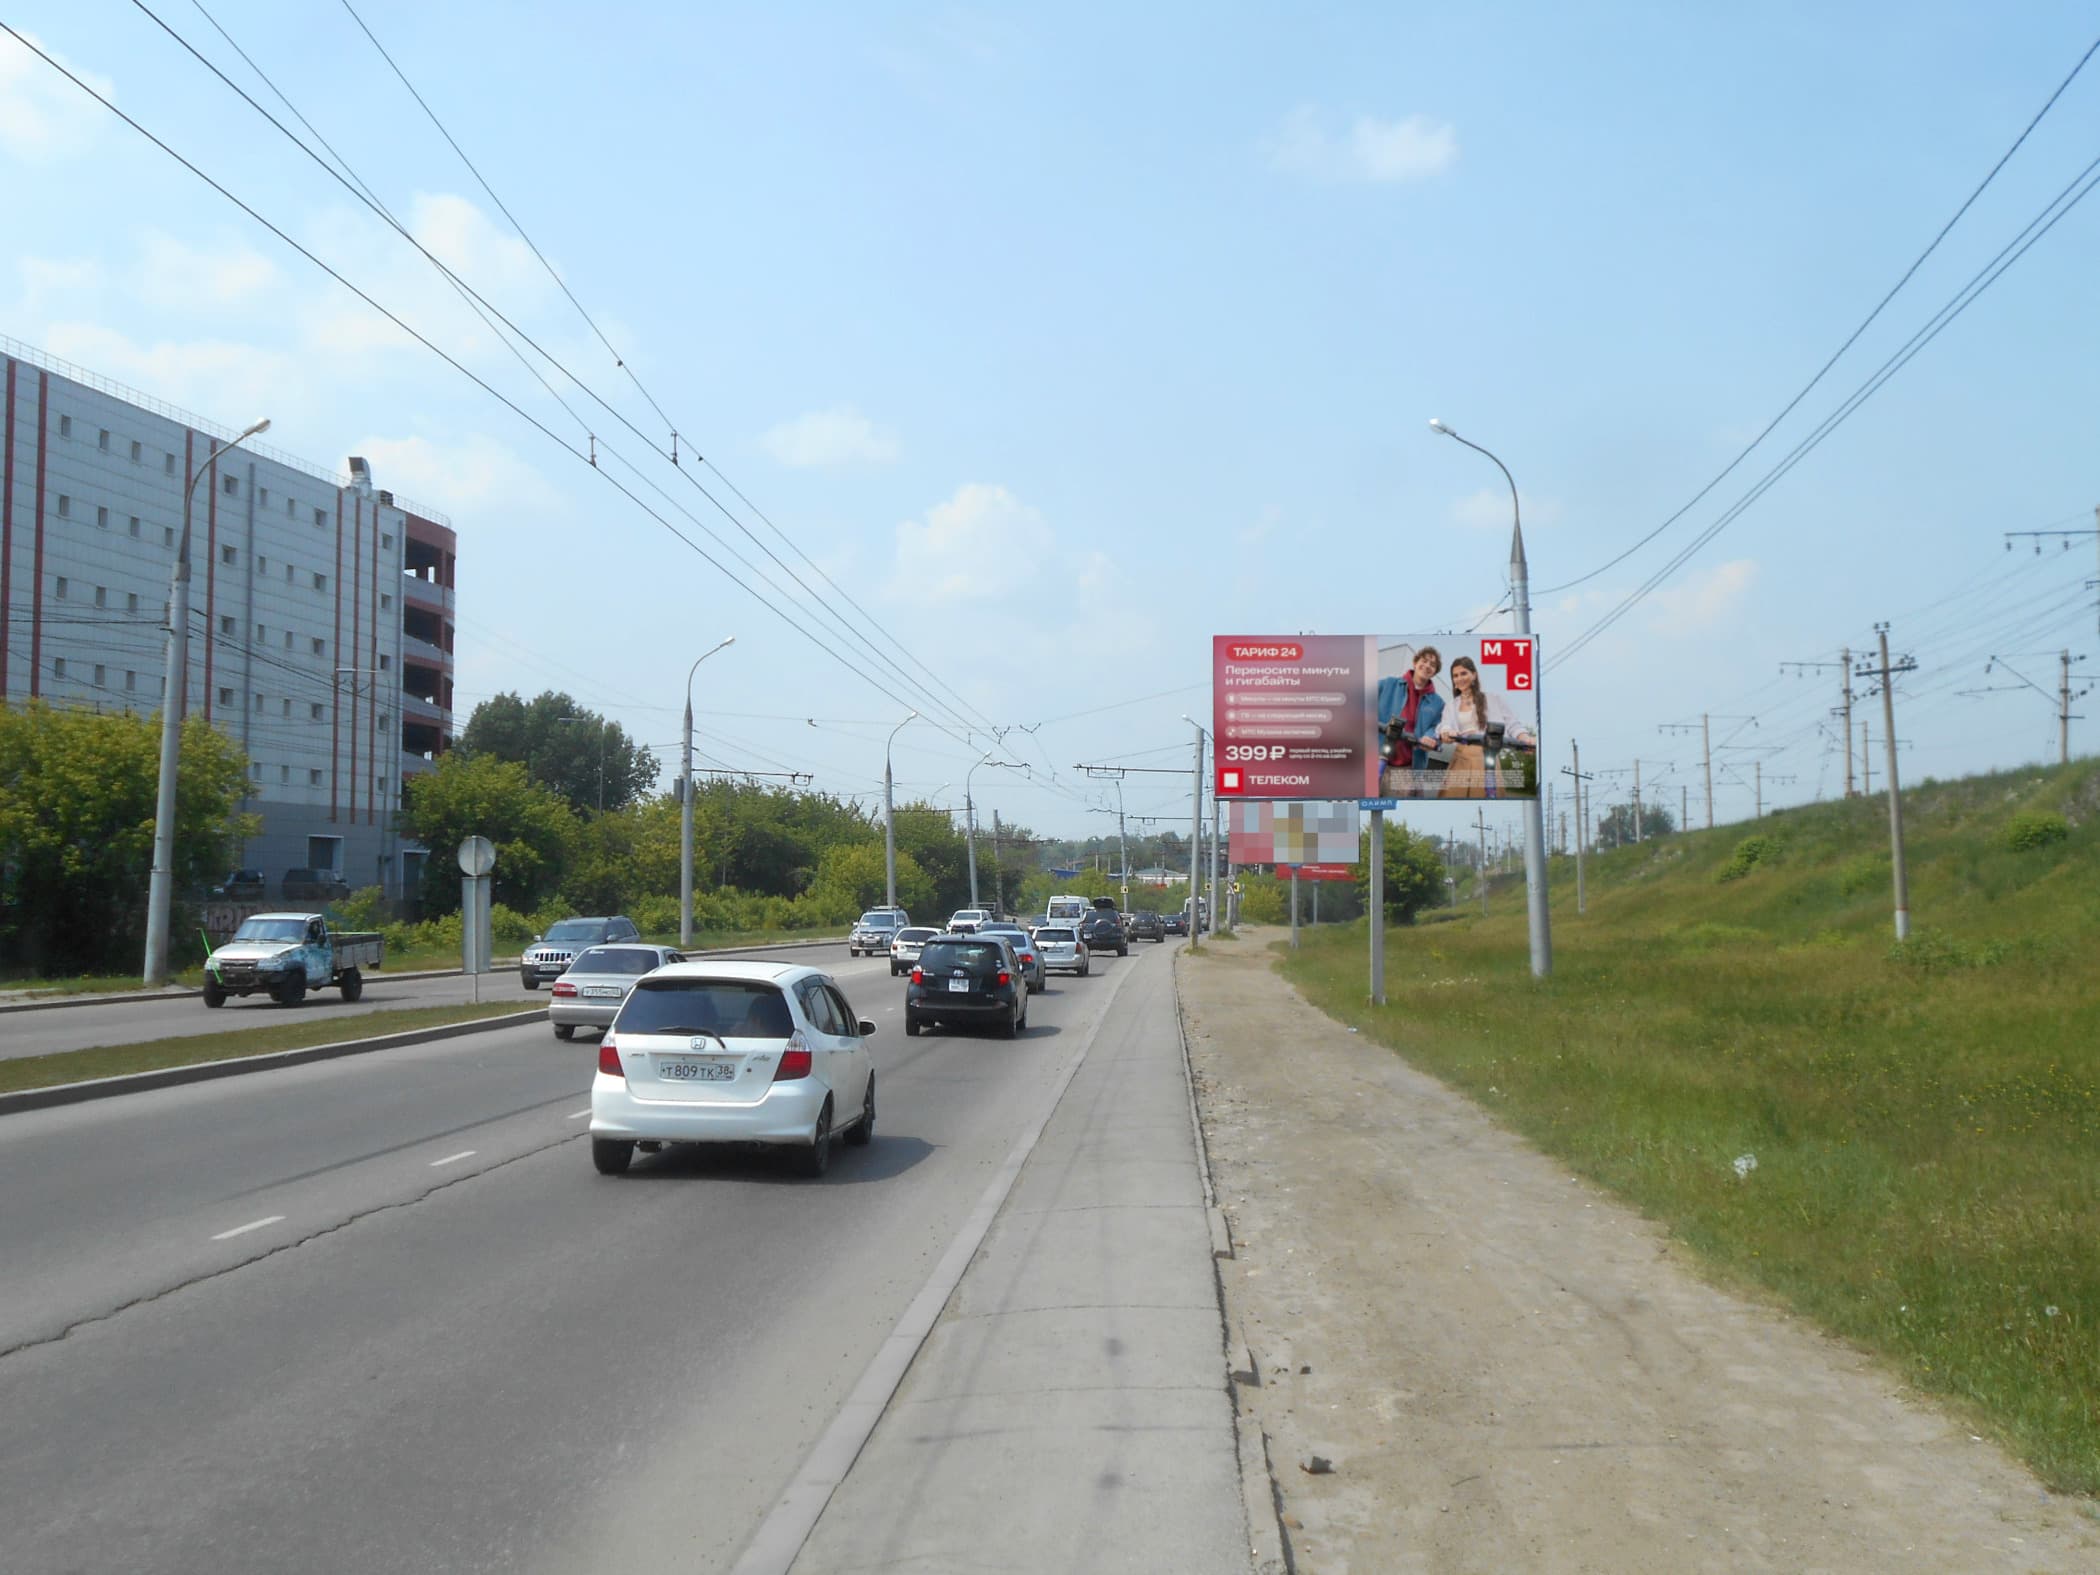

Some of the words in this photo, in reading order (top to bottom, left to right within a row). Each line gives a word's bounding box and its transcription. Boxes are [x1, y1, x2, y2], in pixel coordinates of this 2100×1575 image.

[1233, 647, 1279, 657] ТАРИФ
[1280, 647, 1297, 657] 24
[1225, 665, 1300, 676] Переносите
[1302, 667, 1350, 677] минуты
[1225, 678, 1233, 686] и
[1235, 676, 1301, 686] гигабайты
[1248, 775, 1310, 785] ТЕЛЕКОМ
